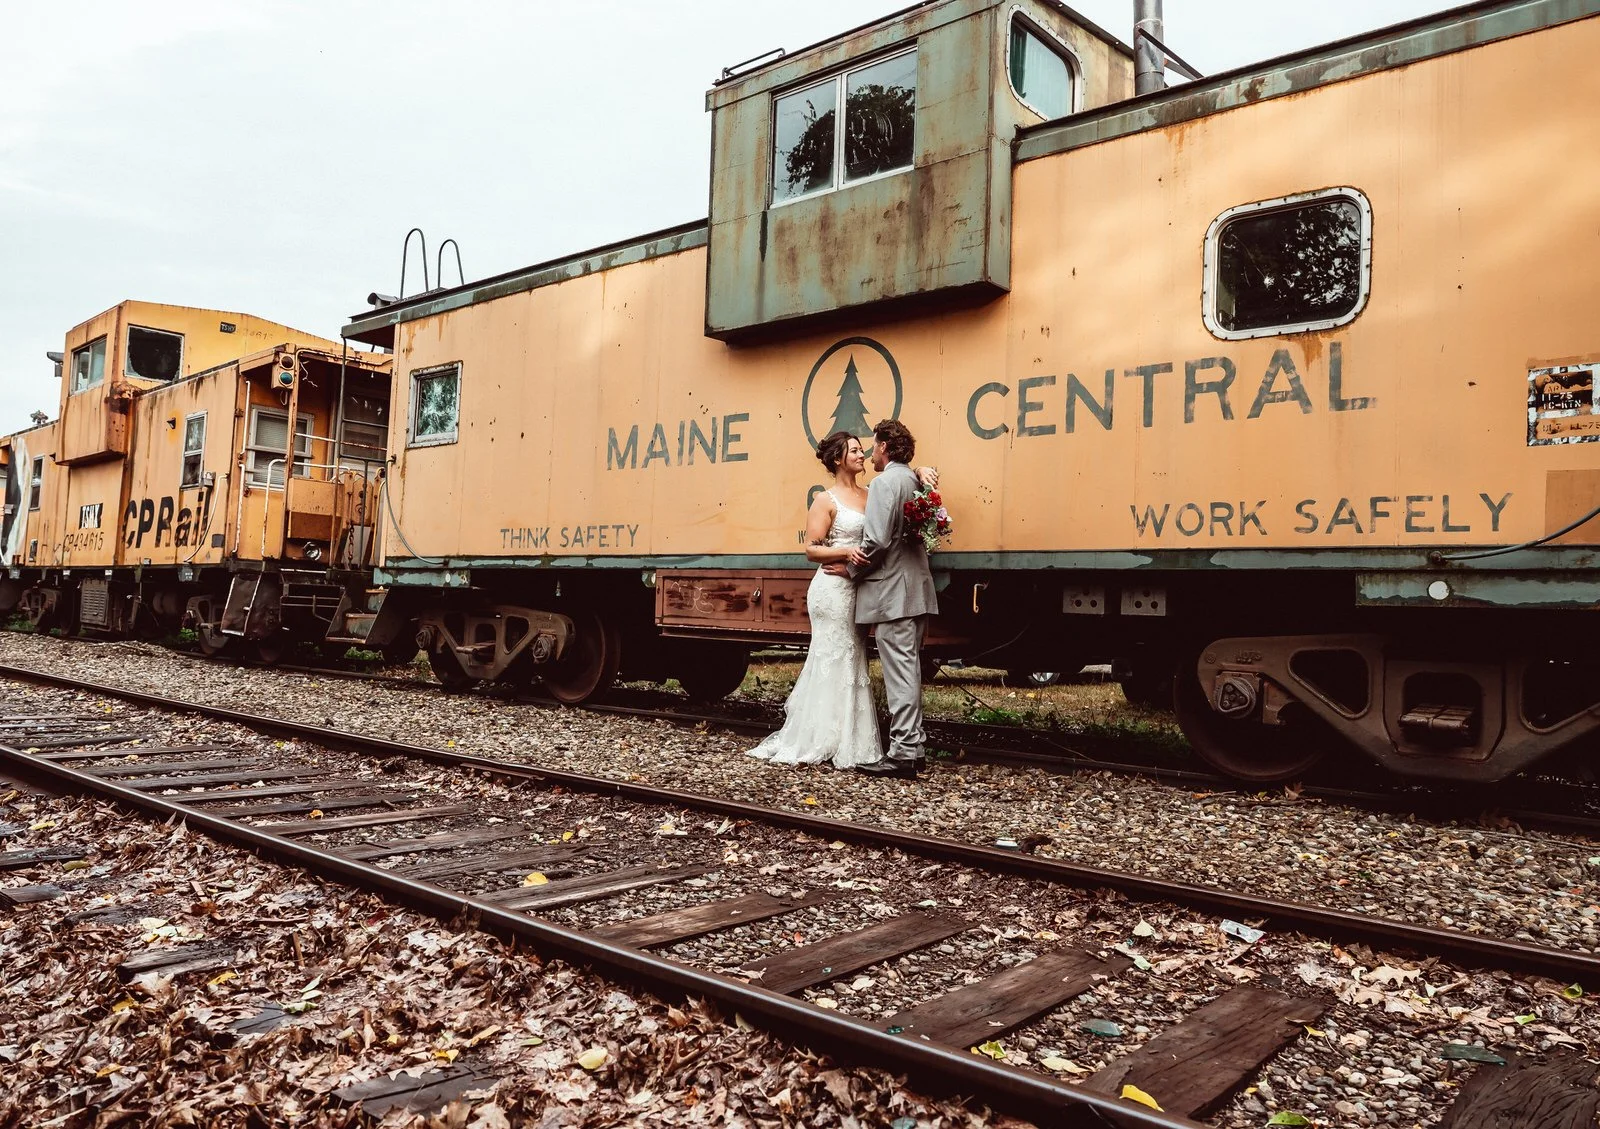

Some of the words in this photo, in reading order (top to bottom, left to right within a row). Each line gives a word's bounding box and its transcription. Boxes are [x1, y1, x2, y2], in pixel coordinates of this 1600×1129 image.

[607, 412, 750, 471] MAINE
[967, 341, 1378, 440] CENTRAL
[81, 503, 100, 529] TSHX
[1130, 500, 1268, 538] WORK
[1294, 492, 1514, 534] SAFELY
[500, 527, 551, 549] THINK
[559, 524, 640, 548] SAFETY
